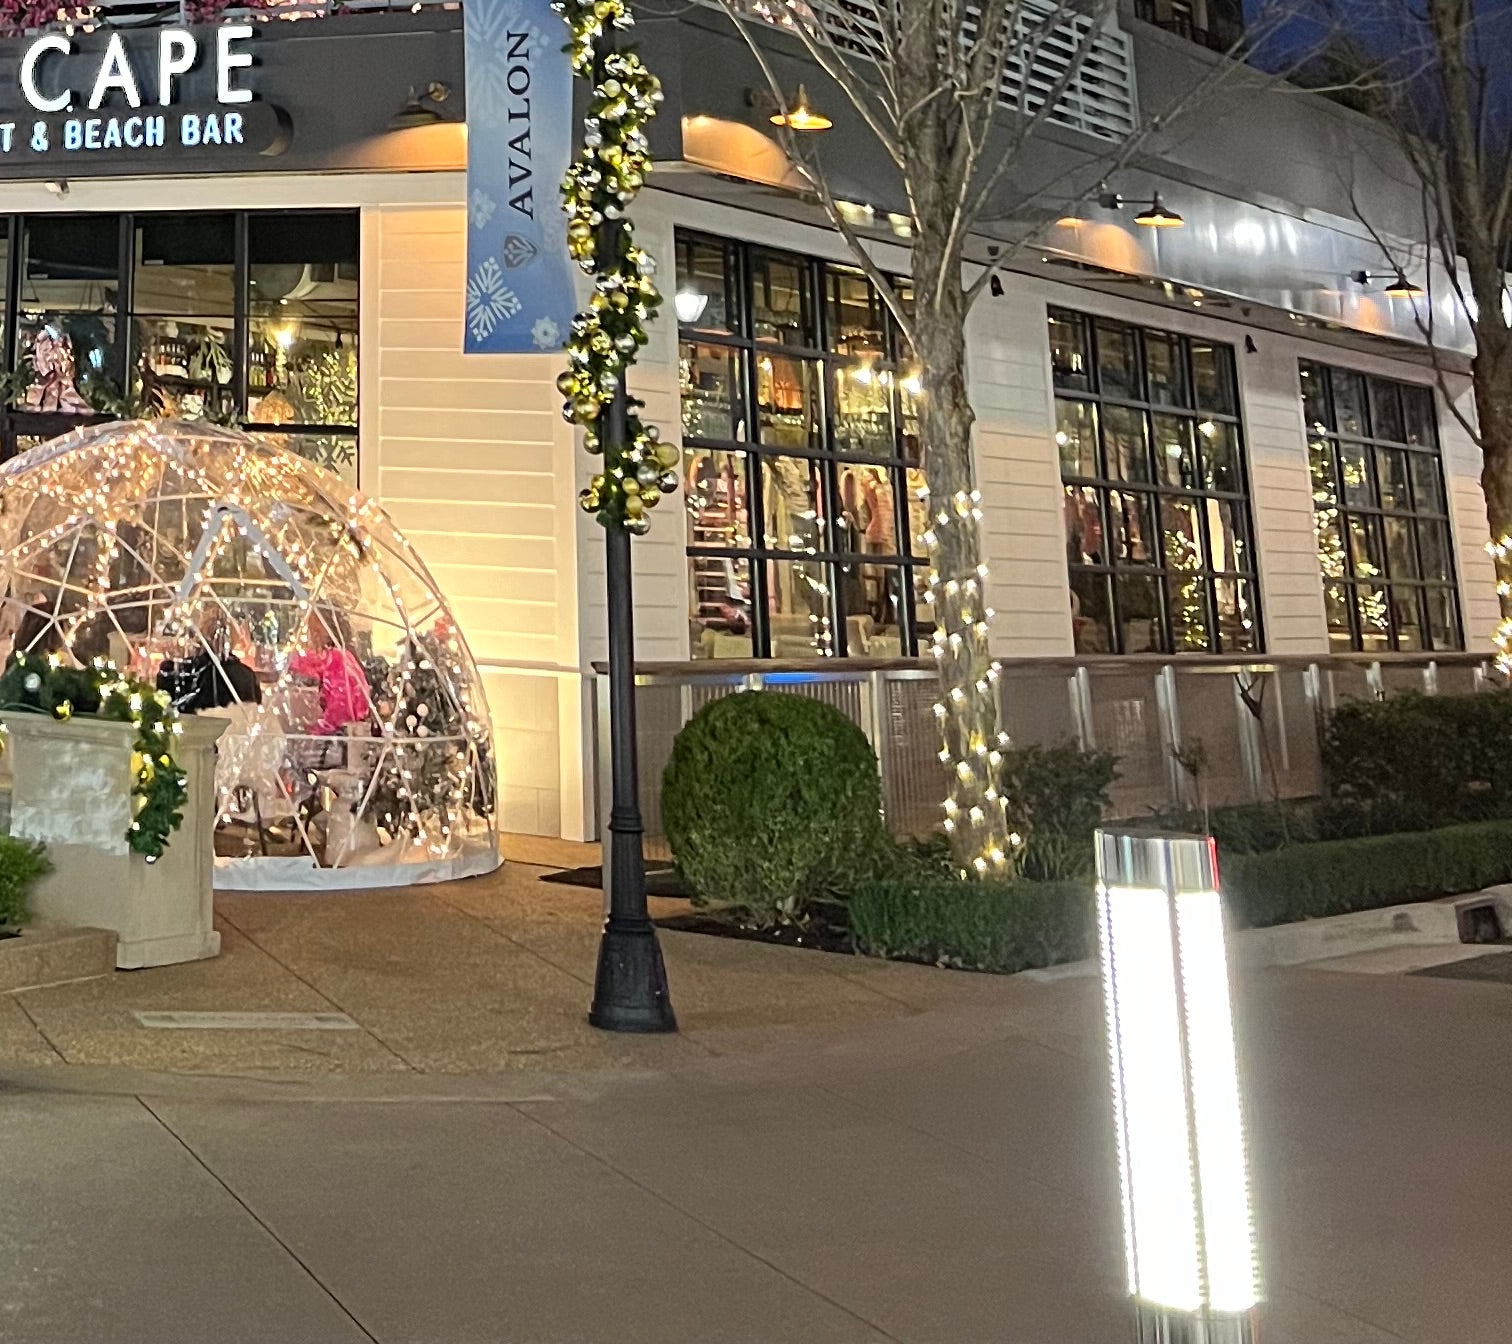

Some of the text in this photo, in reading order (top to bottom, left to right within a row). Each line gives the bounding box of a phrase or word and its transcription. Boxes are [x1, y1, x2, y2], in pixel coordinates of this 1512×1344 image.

[20, 25, 255, 113] CAPE
[31, 121, 49, 153] &
[64, 116, 165, 151] BEACH
[181, 111, 245, 146] BAR
[506, 30, 534, 220] AVALON
